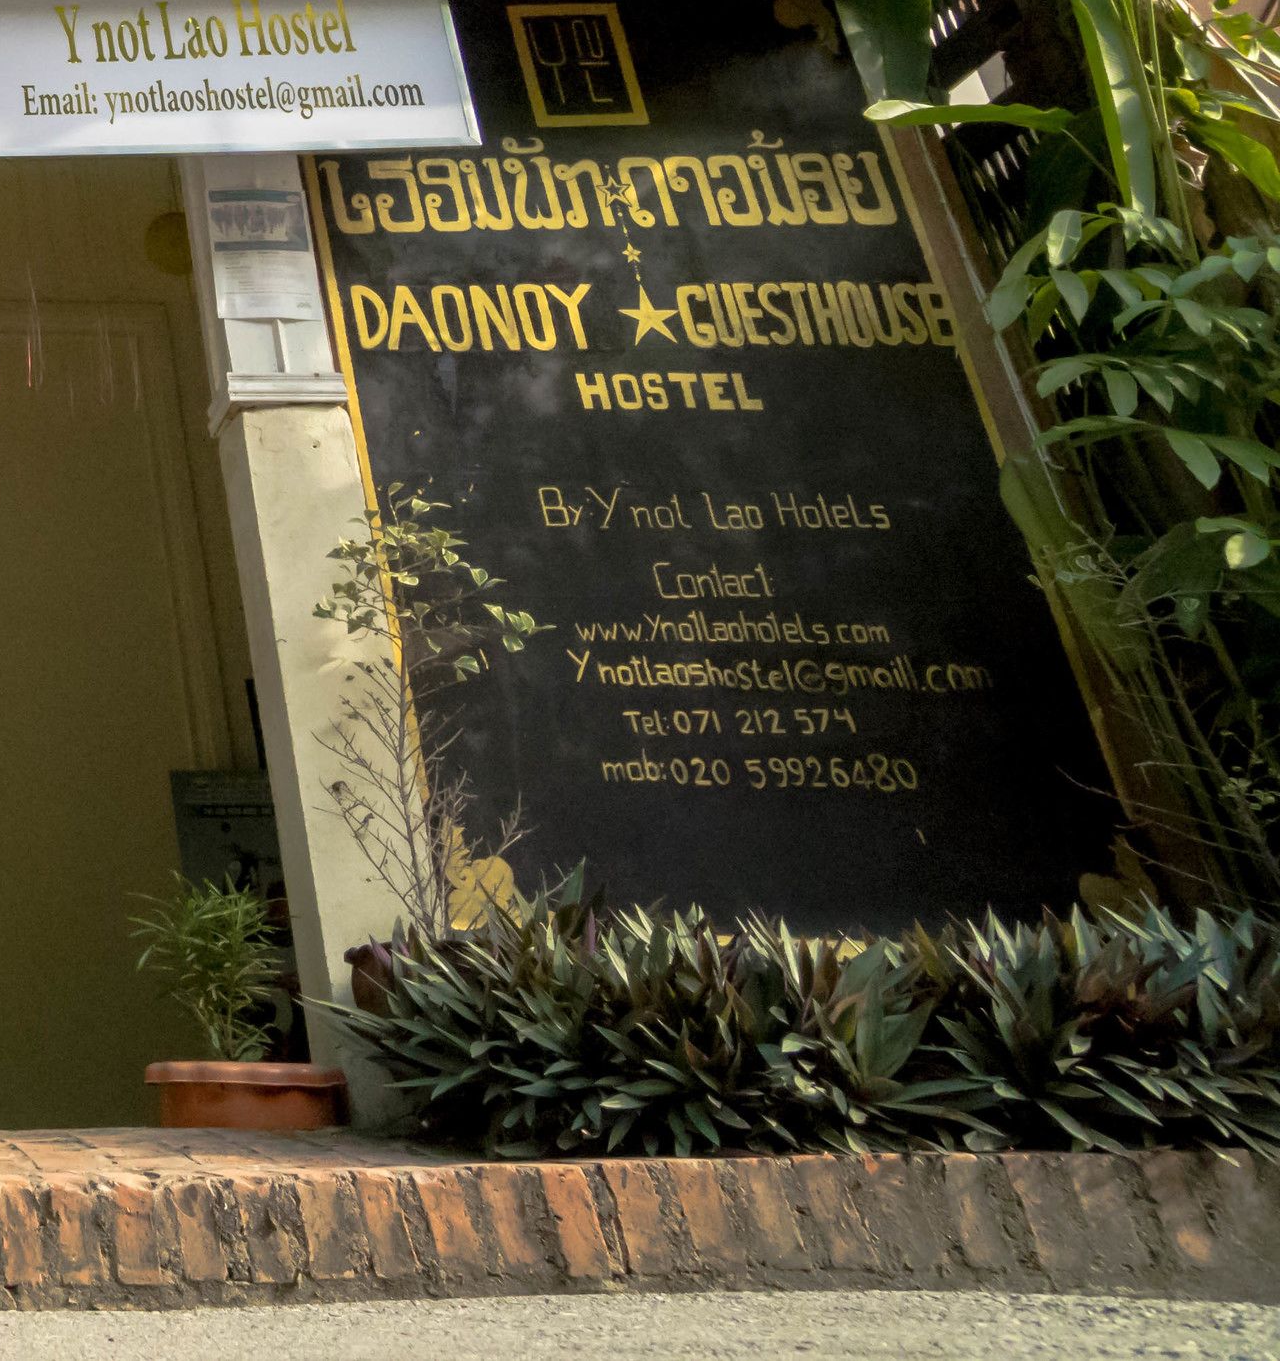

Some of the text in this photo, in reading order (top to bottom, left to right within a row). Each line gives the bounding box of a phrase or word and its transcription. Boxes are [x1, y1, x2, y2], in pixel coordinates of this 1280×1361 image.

[54, 4, 83, 64] Y
[92, 7, 156, 63] not
[156, 0, 229, 61] Lao
[21, 73, 426, 125] Email: ynotlaoshostel@gmail.com
[349, 280, 957, 353] DAONOY GUESTHOUSE
[574, 371, 764, 412] HOSTEL
[629, 493, 693, 529] not
[736, 708, 786, 735] 212
[795, 708, 857, 735] 574
[744, 752, 918, 792] 59926480
